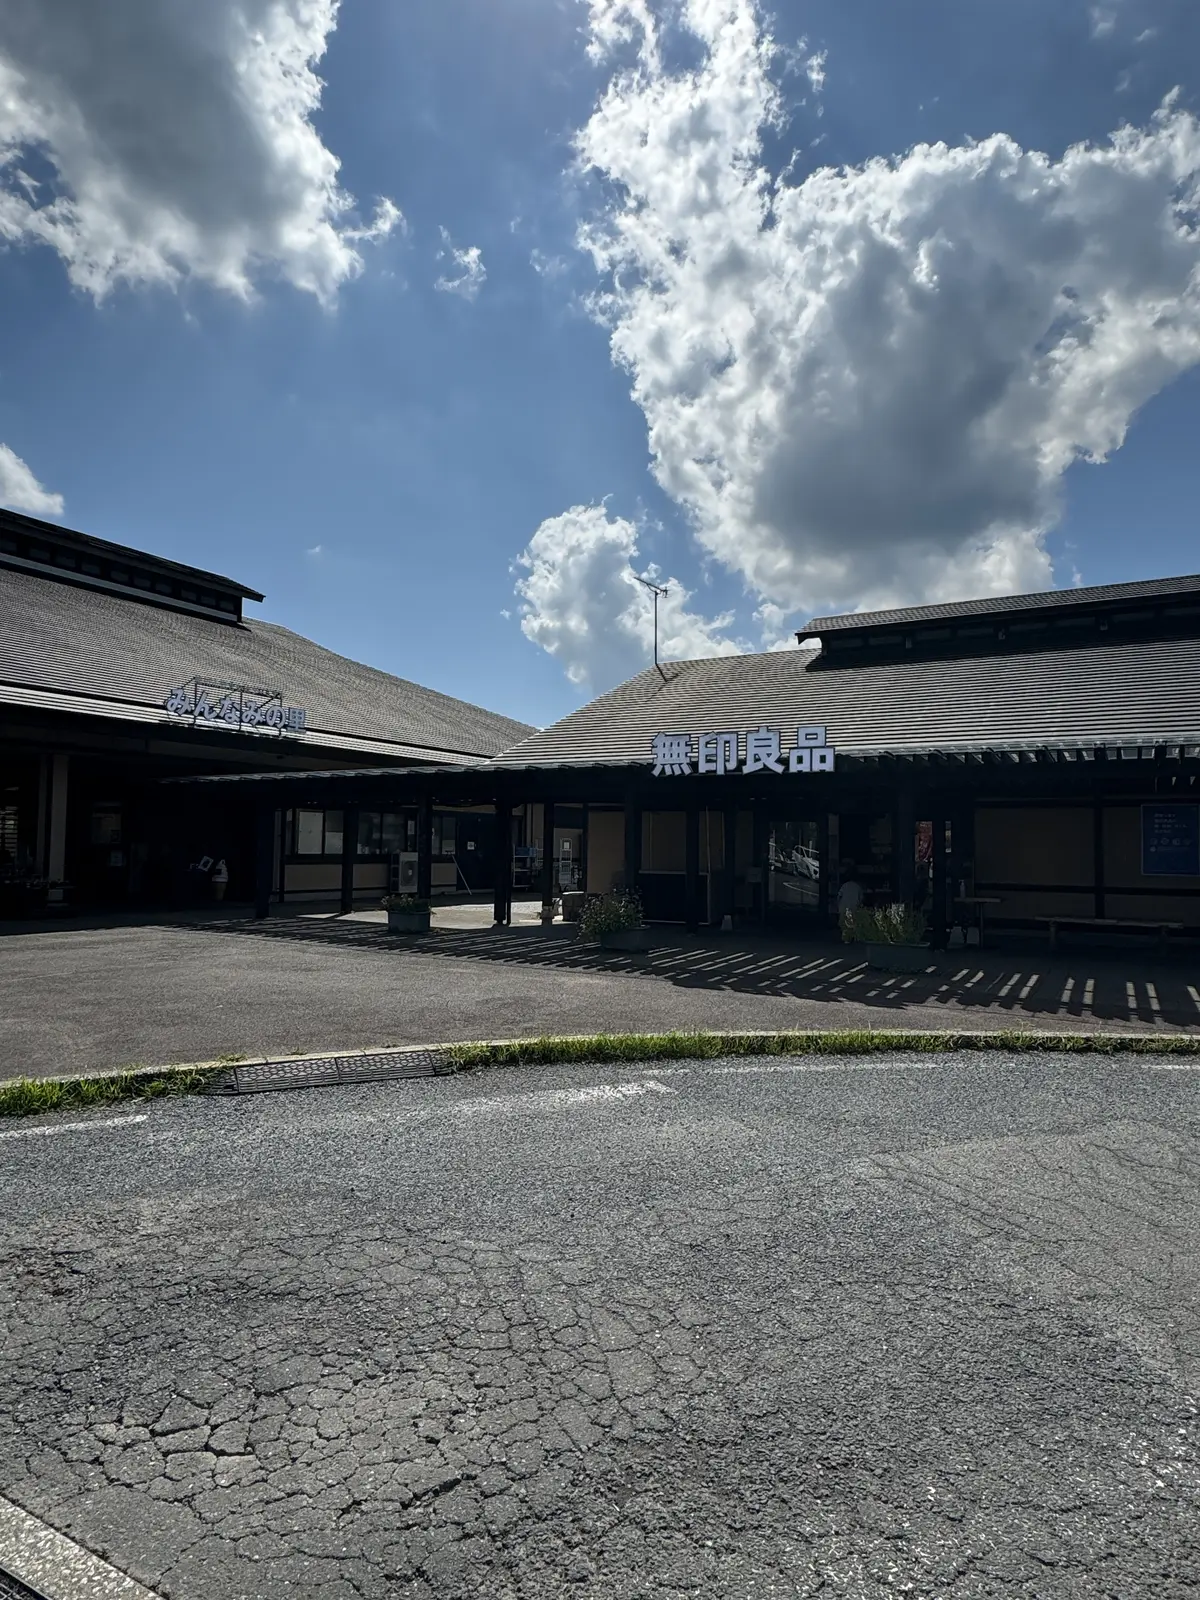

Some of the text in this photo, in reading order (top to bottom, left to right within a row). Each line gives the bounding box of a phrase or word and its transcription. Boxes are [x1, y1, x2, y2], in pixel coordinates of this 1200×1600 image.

[166, 688, 306, 733] みんなみの里
[651, 725, 836, 778] 無印良品
